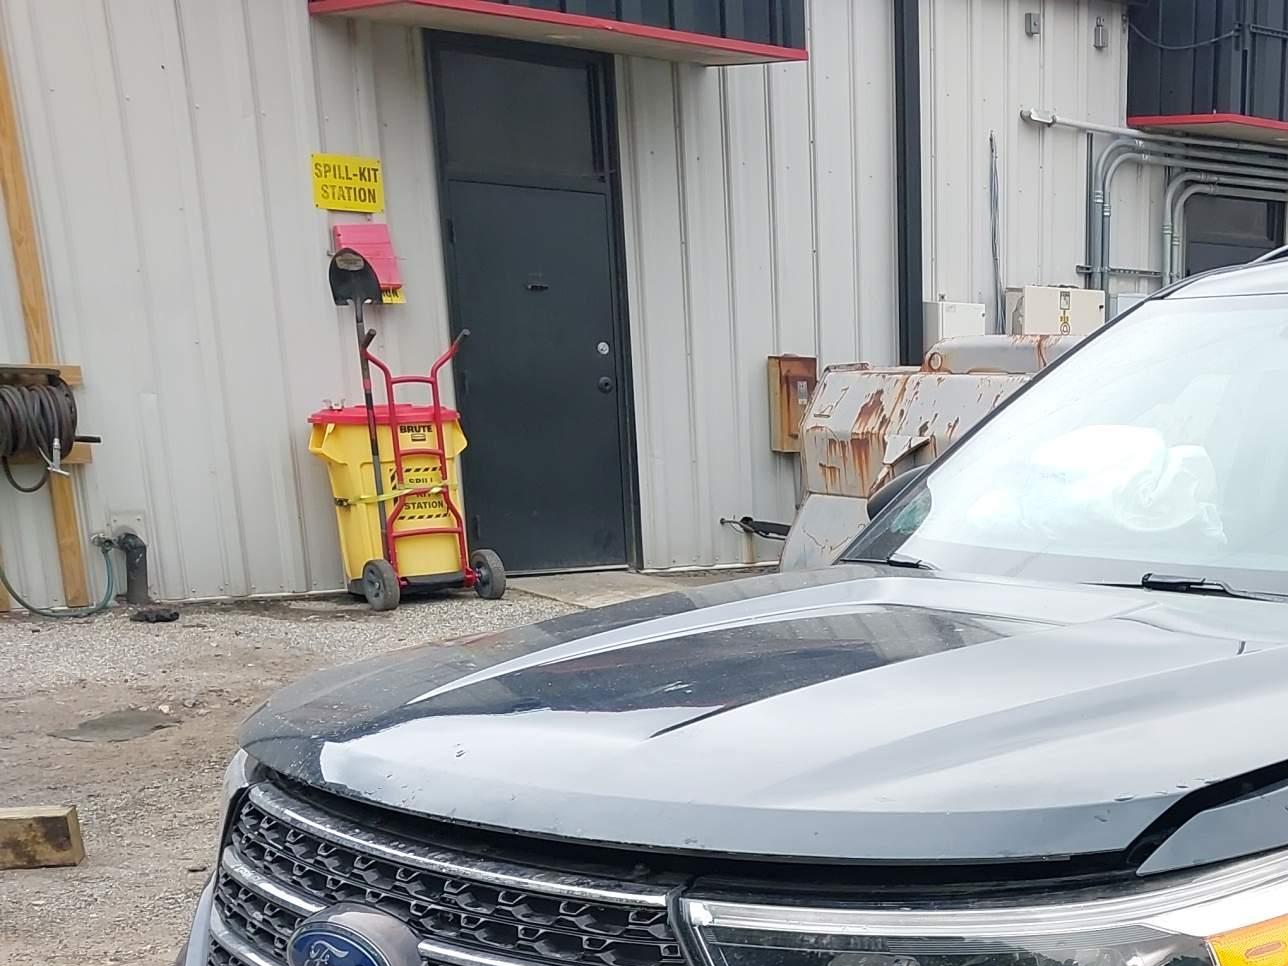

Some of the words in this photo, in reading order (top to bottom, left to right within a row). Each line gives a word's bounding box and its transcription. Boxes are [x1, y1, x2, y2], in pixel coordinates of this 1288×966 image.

[314, 162, 379, 183] SPILL-KIT
[321, 184, 377, 203] STATION
[400, 425, 433, 433] BRUTE
[404, 501, 444, 510] STATION
